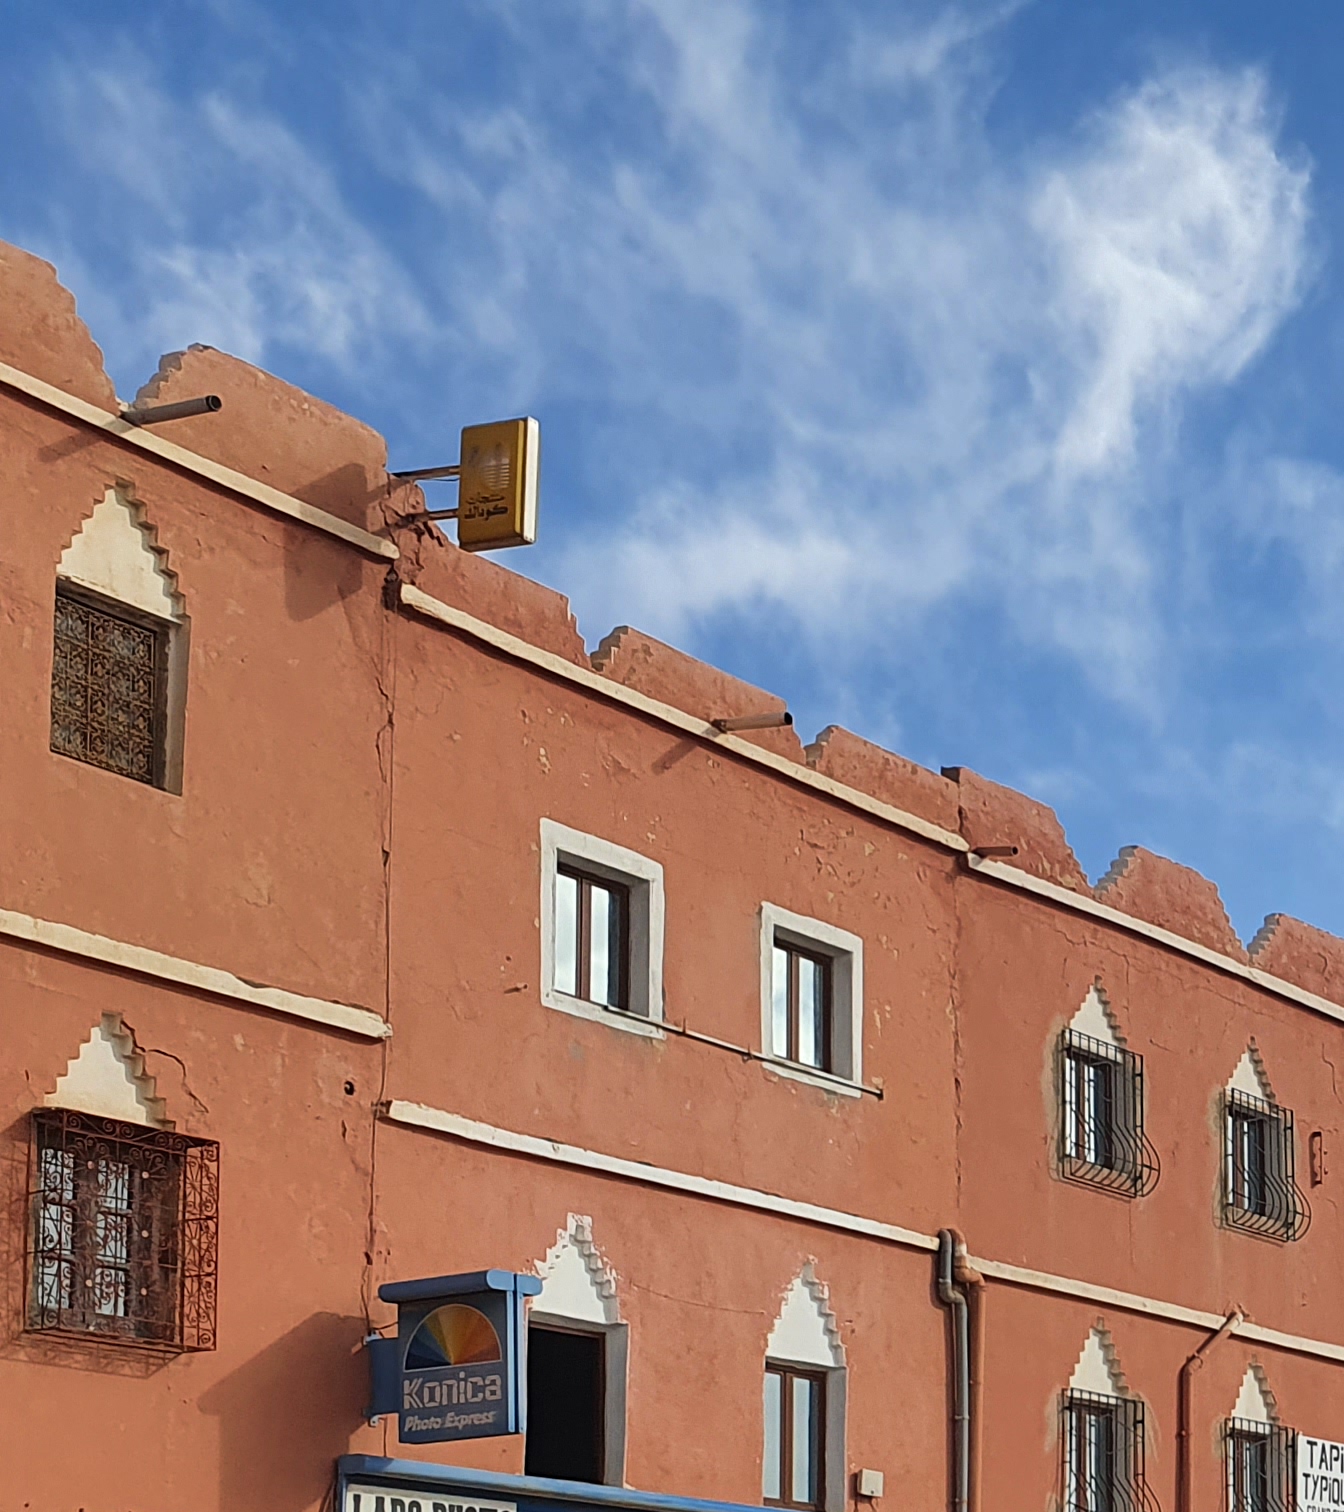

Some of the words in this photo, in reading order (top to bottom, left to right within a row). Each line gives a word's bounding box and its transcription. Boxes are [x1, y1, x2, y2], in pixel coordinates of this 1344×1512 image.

[403, 1371, 502, 1410] Konica
[404, 1415, 442, 1432] Photo
[443, 1411, 497, 1430] Express
